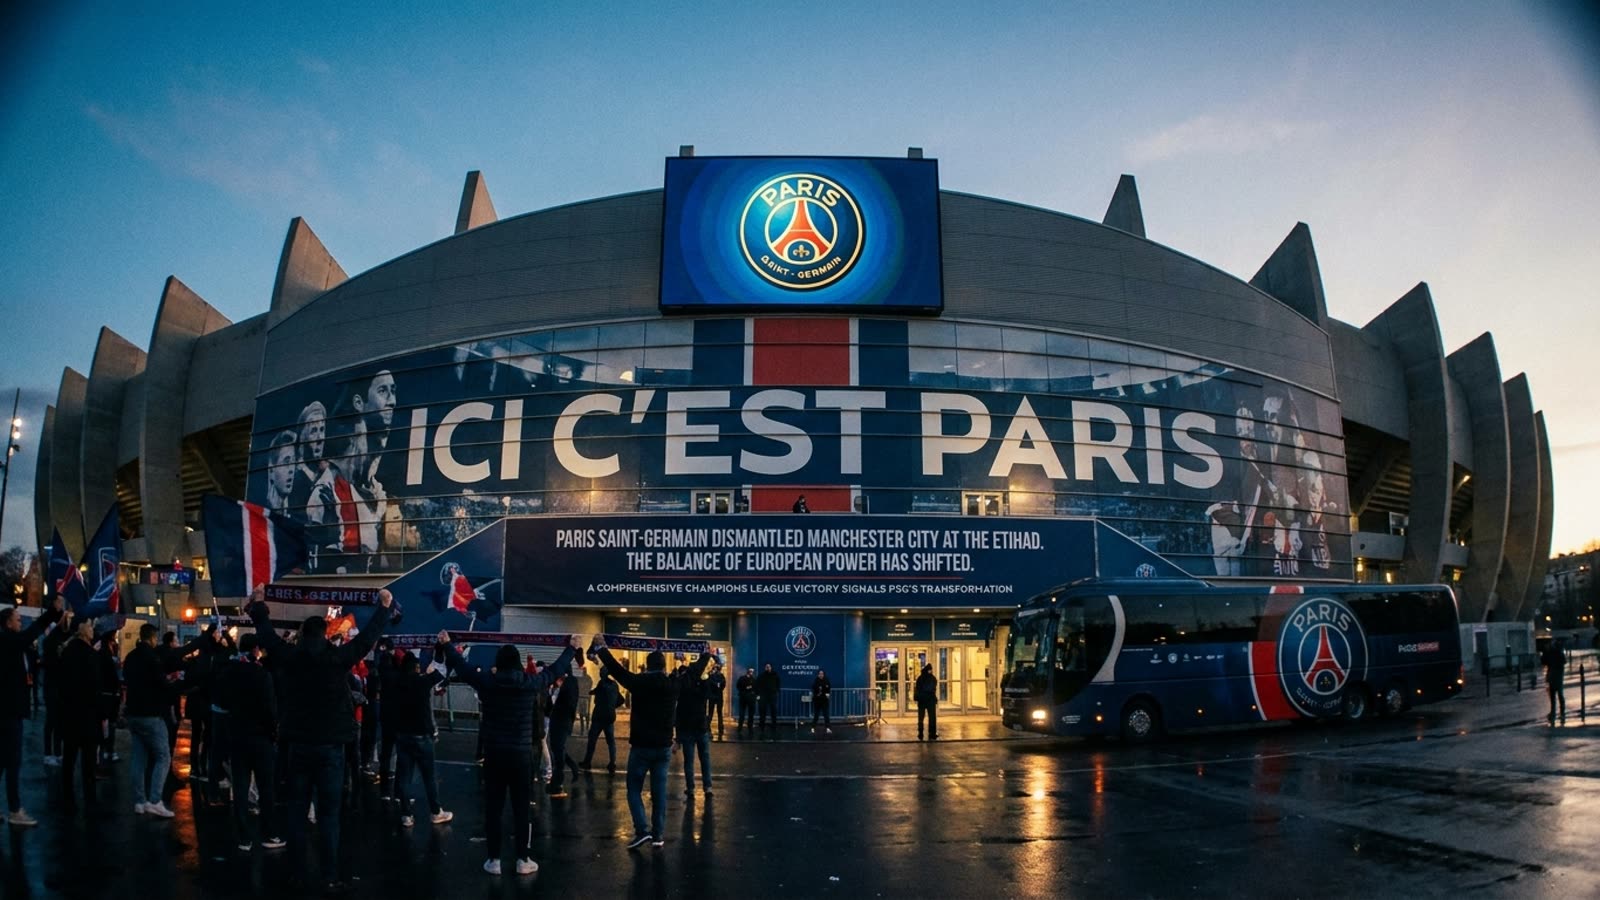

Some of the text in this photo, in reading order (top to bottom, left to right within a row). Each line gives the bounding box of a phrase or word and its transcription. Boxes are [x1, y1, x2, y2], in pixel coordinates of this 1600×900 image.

[760, 179, 841, 207] PARIS
[406, 389, 1224, 489] ICI C'EST PARIS
[556, 529, 1045, 550] PARIS SAINT-GERMAIN DISMANTLED MANCHESTER CITY AT THE ETIHAD.
[626, 552, 975, 572] THE BALANCE OF EUROPEAN POWER HAS SHIFTED.
[587, 584, 595, 593] A
[597, 584, 683, 593] COMPREHENSIVE
[685, 584, 748, 593] CHAMPIONS
[750, 584, 791, 593] LEAGUE
[794, 585, 840, 594] VICTORY
[842, 585, 887, 594] SIGNALS
[889, 585, 919, 594] PSG'S
[1292, 604, 1352, 632] PARIS
